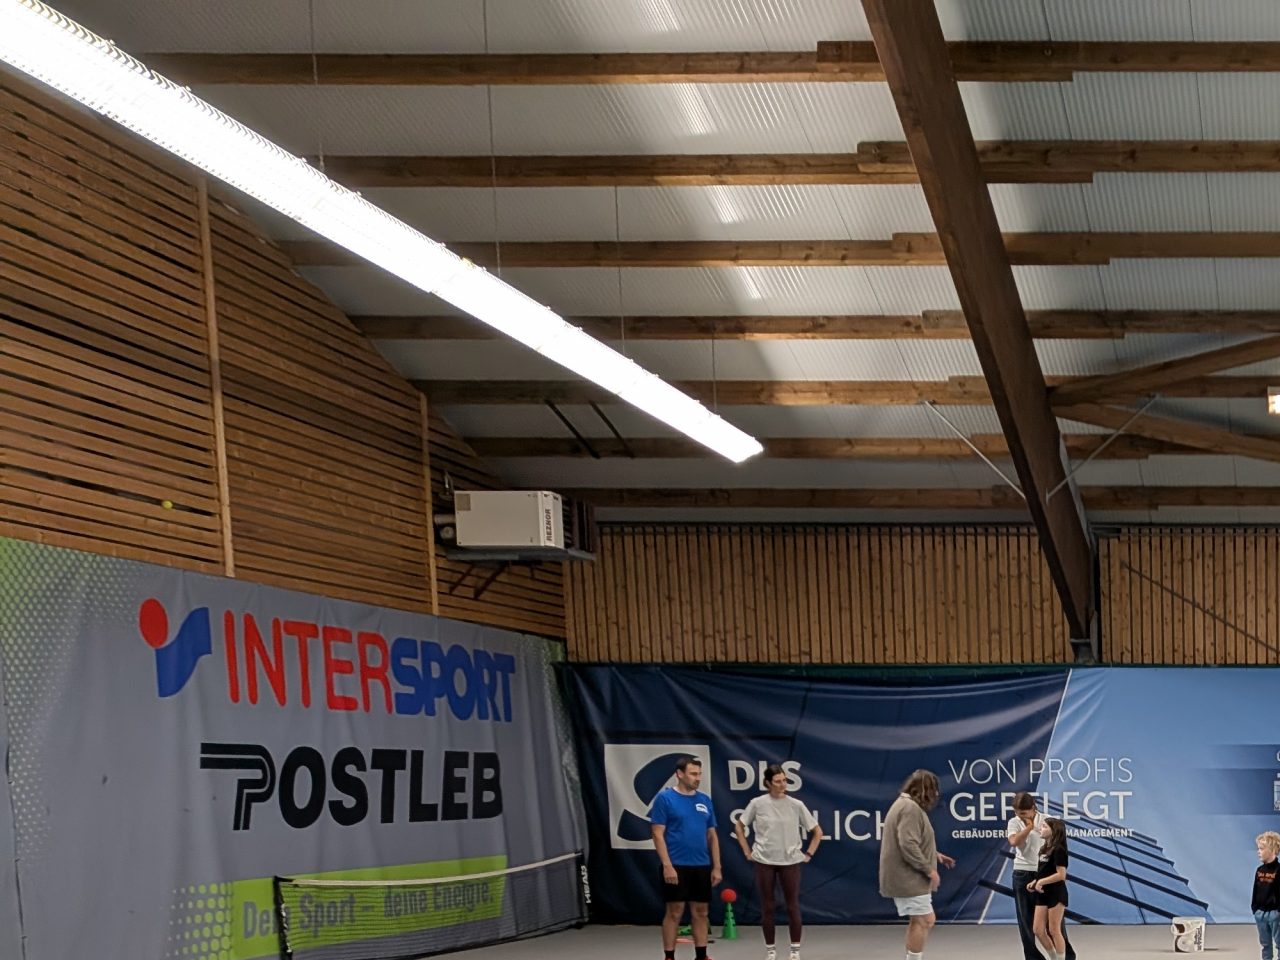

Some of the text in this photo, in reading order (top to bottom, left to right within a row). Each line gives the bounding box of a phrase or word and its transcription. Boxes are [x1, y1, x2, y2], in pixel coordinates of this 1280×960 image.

[223, 609, 516, 723] INTERSPORT
[200, 741, 503, 831] POSTLEB
[727, 760, 803, 791] DLS
[948, 757, 1133, 785] VON PROFIS
[949, 790, 1133, 822] GEPLEGT
[1065, 827, 1135, 838] MANAGEMENT
[300, 892, 357, 938] Sport
[384, 885, 428, 918] deine
